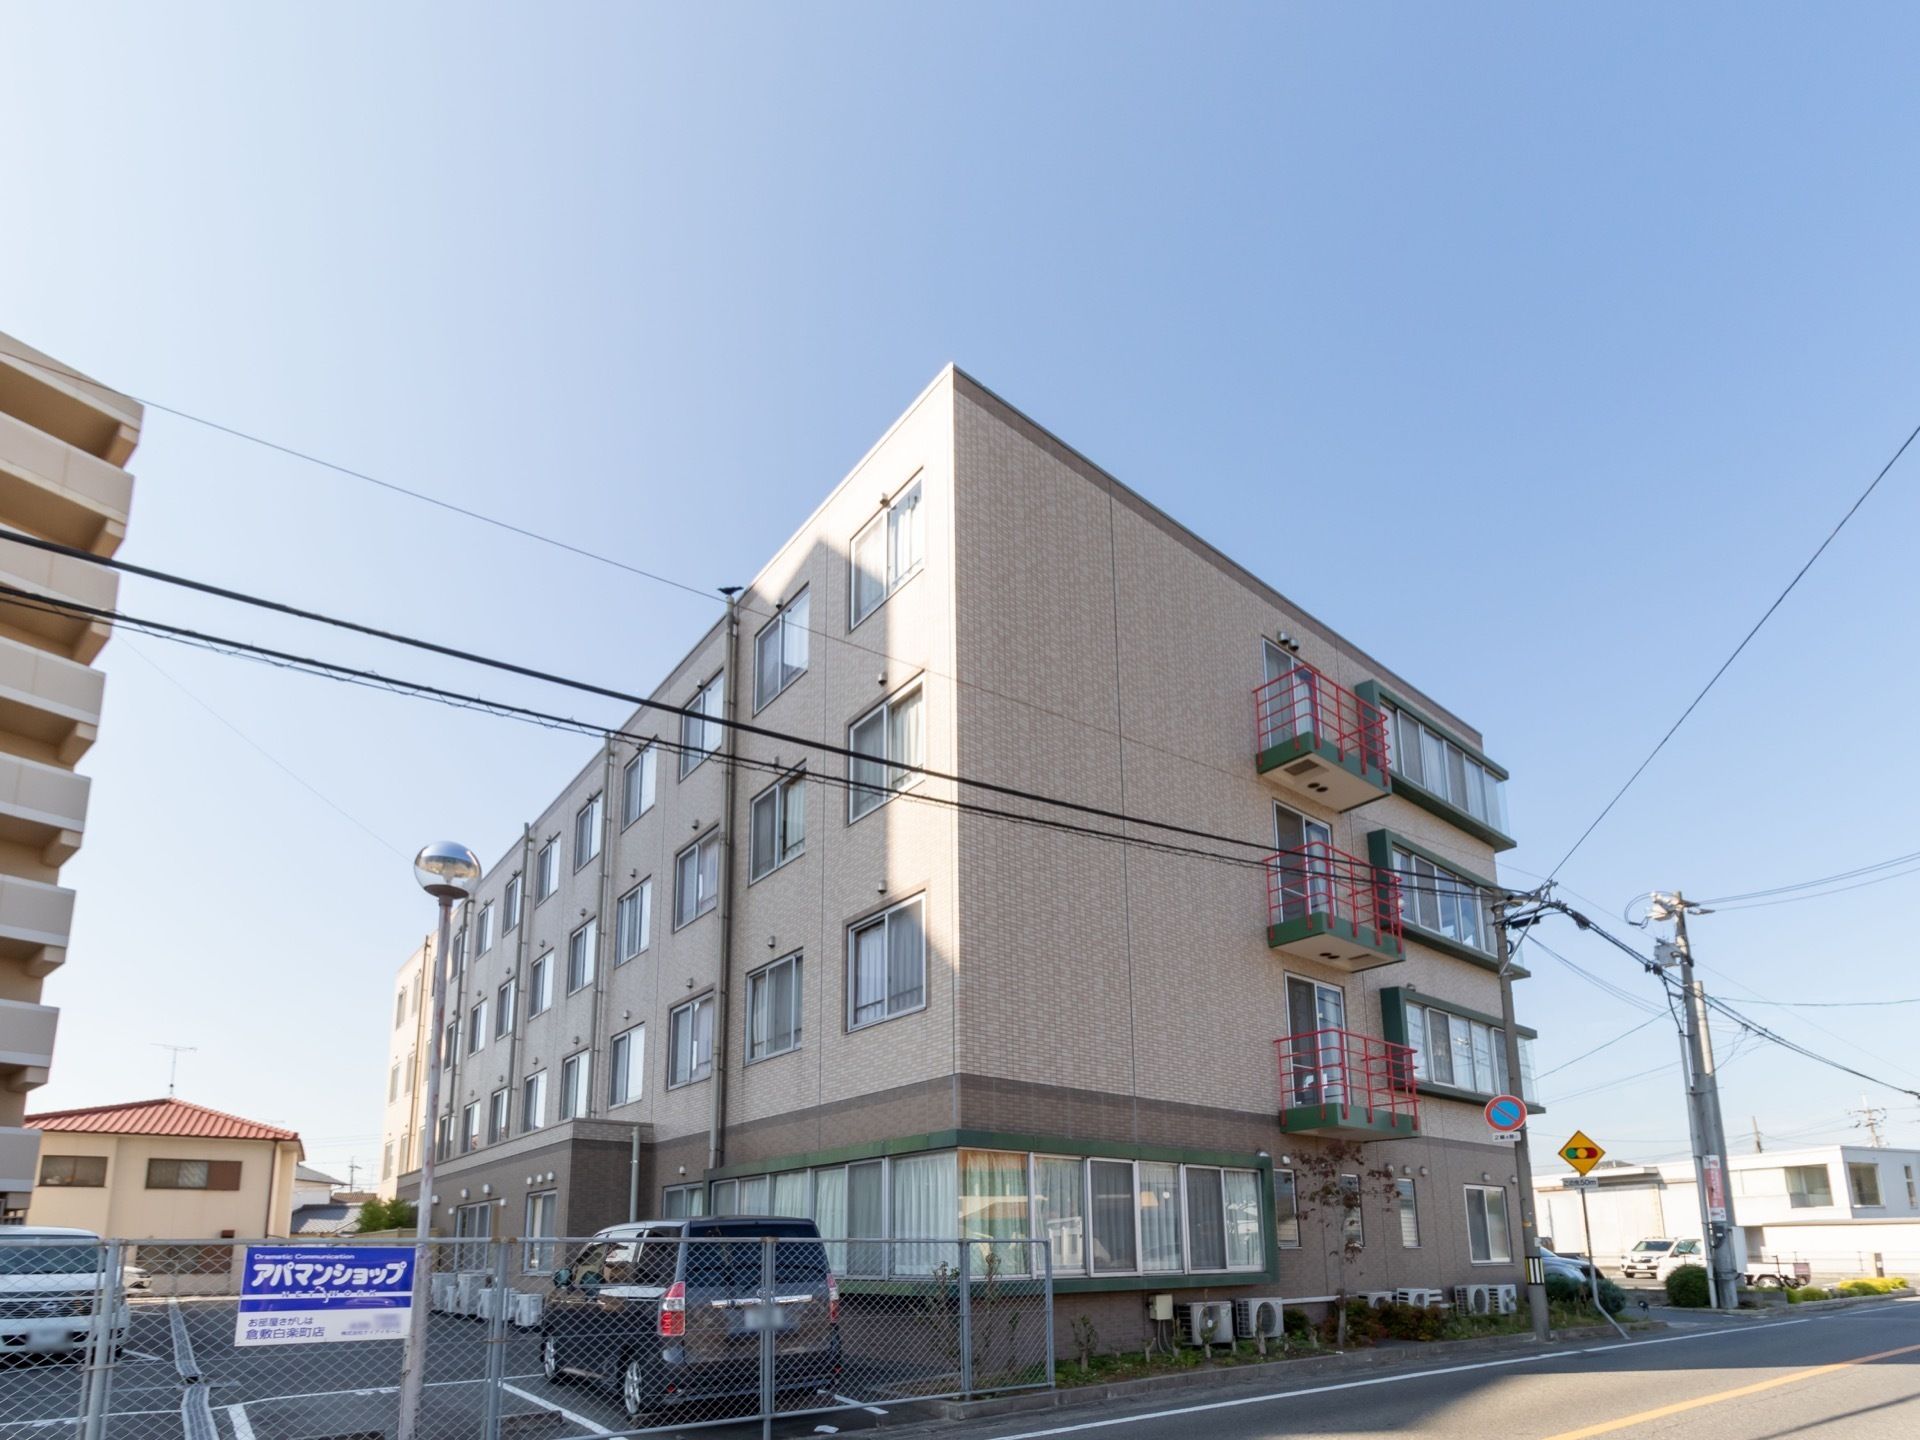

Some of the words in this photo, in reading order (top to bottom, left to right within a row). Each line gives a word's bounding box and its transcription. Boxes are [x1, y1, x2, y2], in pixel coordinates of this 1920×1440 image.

[254, 1253, 294, 1261] Dramatic
[251, 1261, 408, 1287] アパマンショップ
[248, 1317, 313, 1327] お部屋さがしは
[245, 1327, 325, 1340] 倉敷白楽町店
